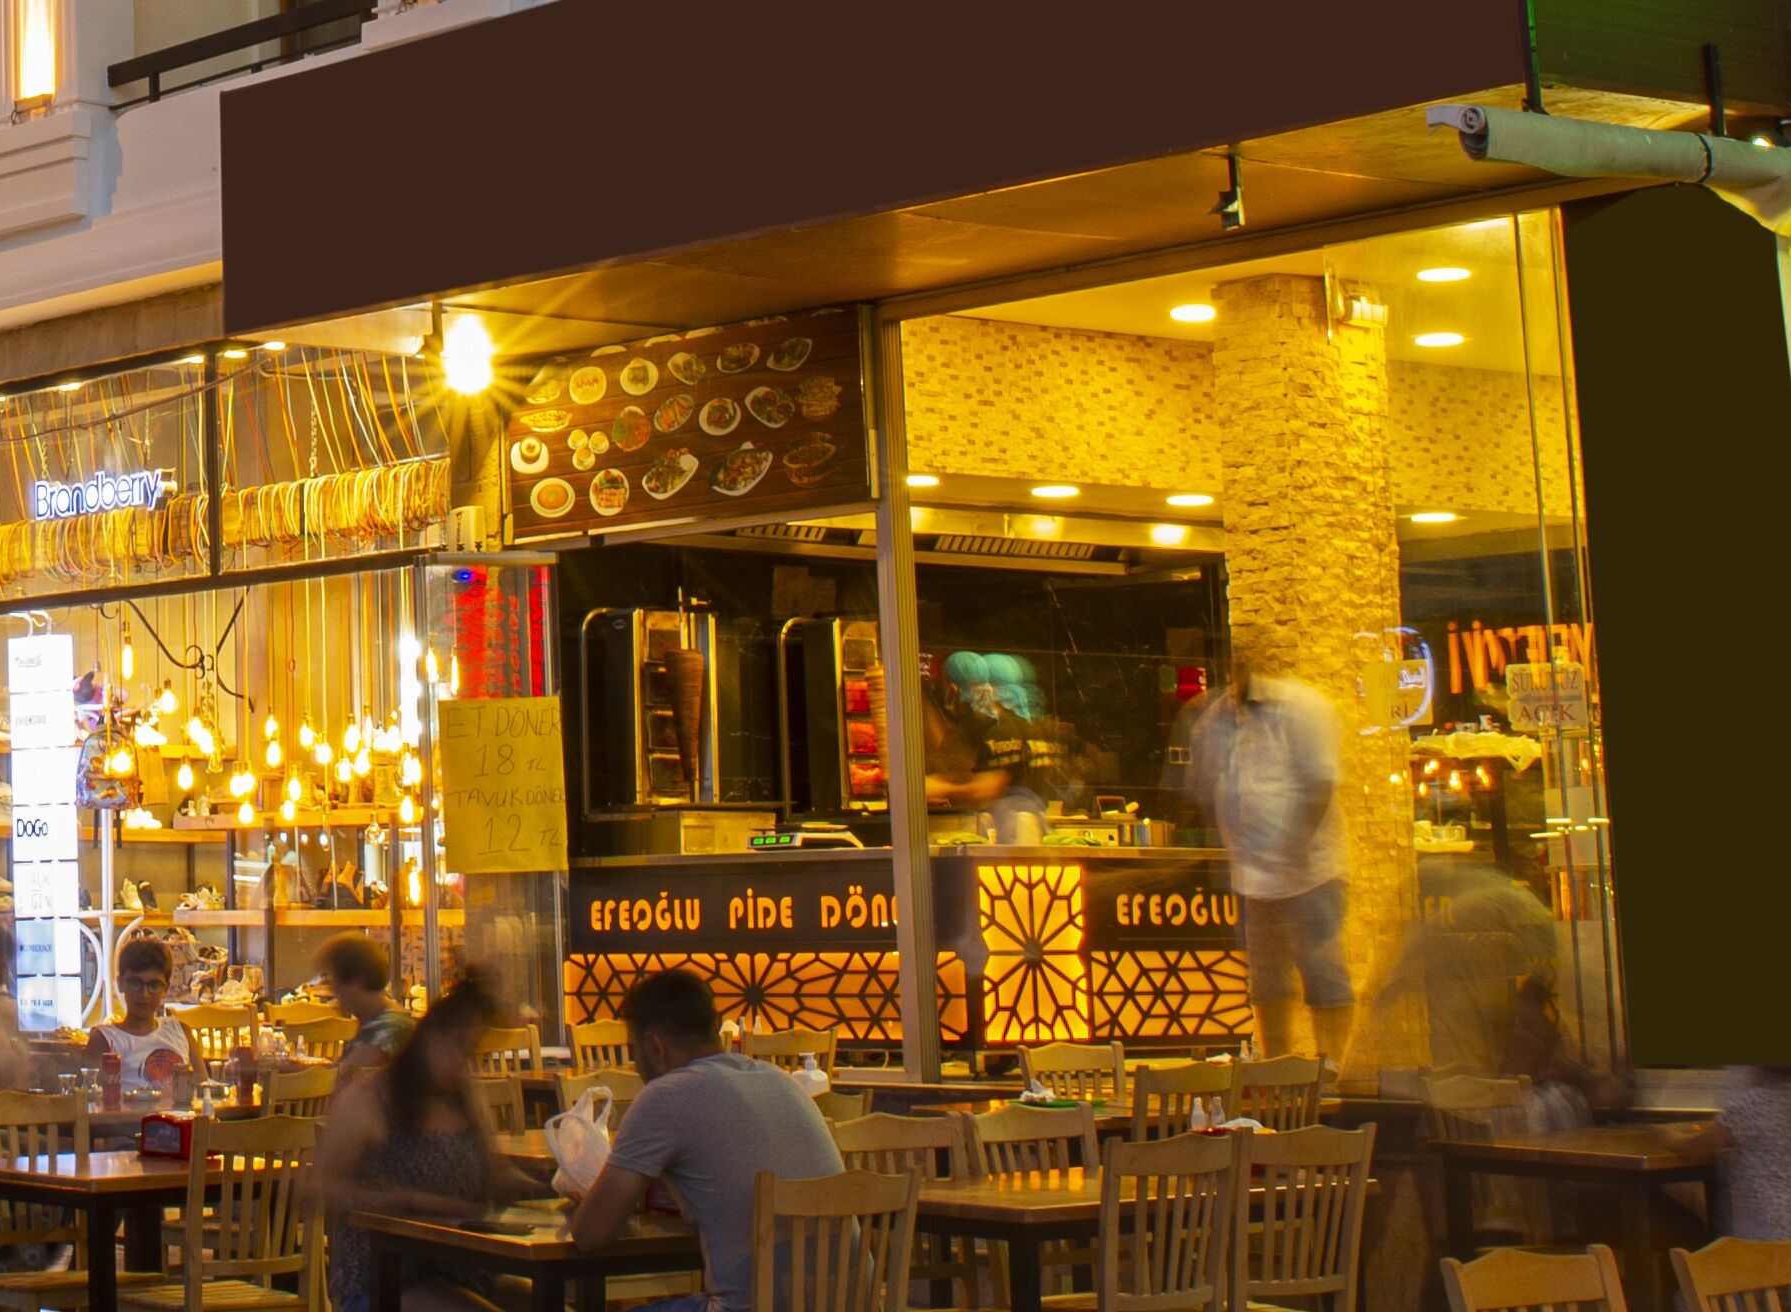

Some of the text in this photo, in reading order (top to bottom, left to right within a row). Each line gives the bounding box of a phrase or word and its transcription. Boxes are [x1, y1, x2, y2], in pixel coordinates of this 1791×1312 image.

[34, 468, 162, 520] Brandberry
[474, 743, 516, 778] 18
[477, 813, 531, 856] 12
[590, 891, 701, 931] EFEOĞLU
[729, 887, 793, 929] PİDE
[1116, 887, 1239, 926] EFEOĞLU
